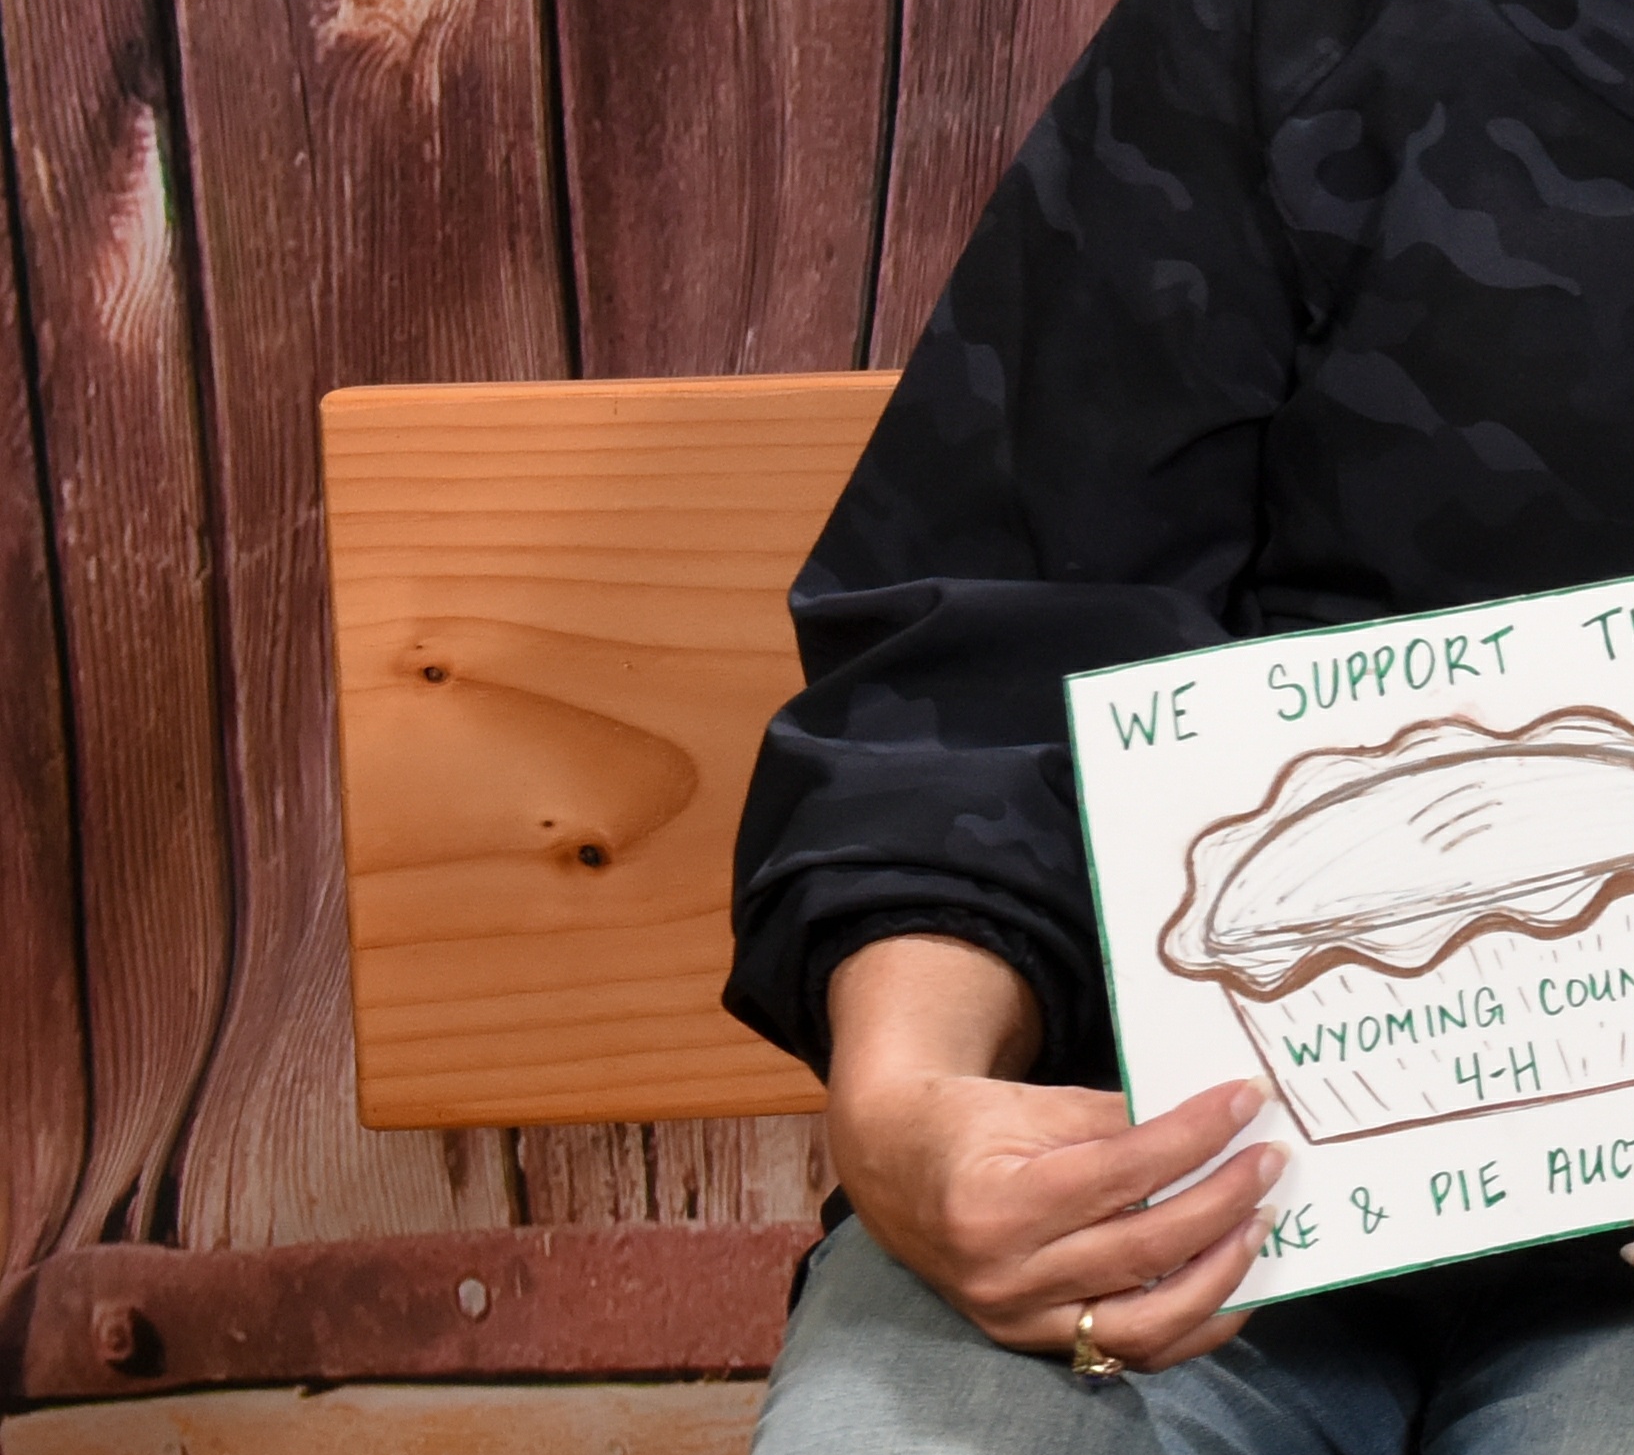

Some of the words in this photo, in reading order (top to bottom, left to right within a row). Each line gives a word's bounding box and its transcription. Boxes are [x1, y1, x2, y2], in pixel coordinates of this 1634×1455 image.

[1109, 681, 1199, 750] WE
[1266, 625, 1517, 722] SUPPORT
[1283, 985, 1505, 1069] WYOMING
[1455, 1042, 1541, 1101] 4-H
[1349, 1185, 1390, 1235] &
[1430, 1160, 1508, 1217] PIE
